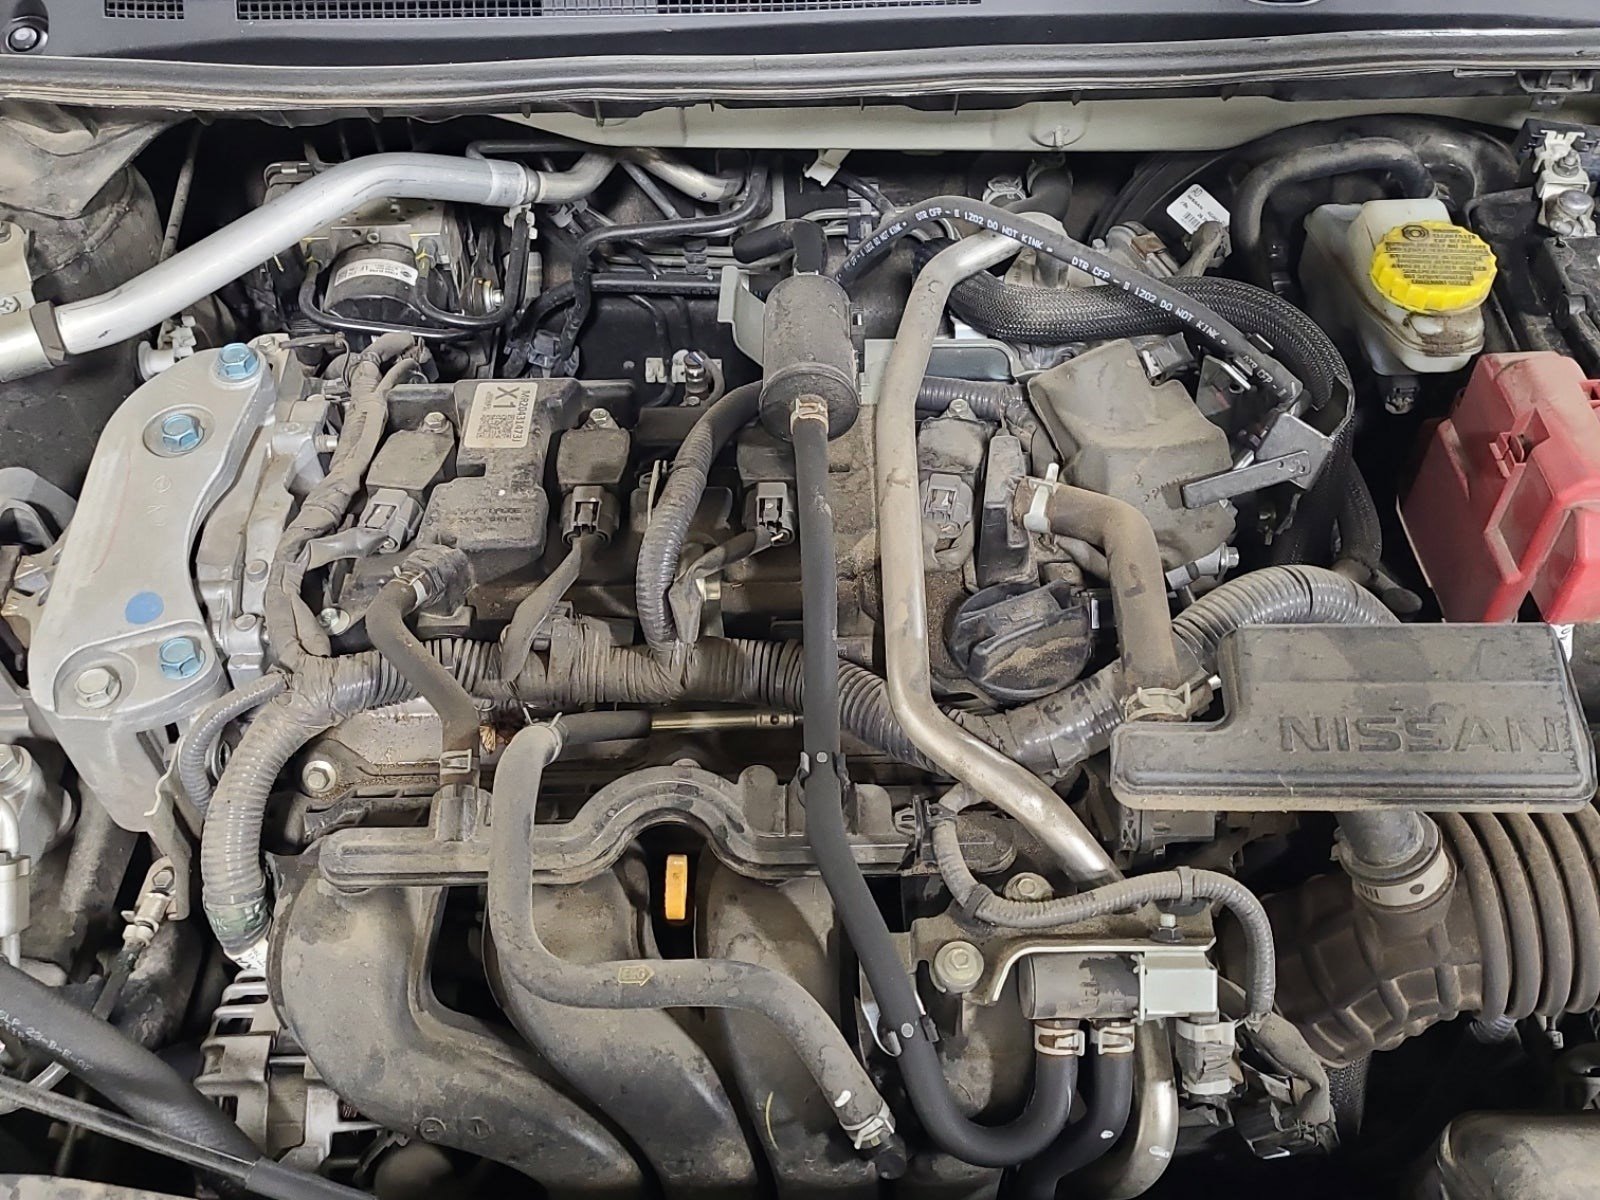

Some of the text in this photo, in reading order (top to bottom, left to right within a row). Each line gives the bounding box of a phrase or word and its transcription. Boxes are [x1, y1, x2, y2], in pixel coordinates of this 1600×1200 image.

[986, 218, 998, 230] DO
[1002, 225, 1018, 238] NOT
[1021, 234, 1045, 249] KINK
[1071, 256, 1090, 271] DTR
[1092, 266, 1111, 280] CFP
[1160, 300, 1173, 311] DO
[1175, 307, 1195, 322] NOT
[1196, 320, 1220, 340] KINK
[492, 386, 520, 408] X1
[1278, 715, 1561, 753] NISSAN
